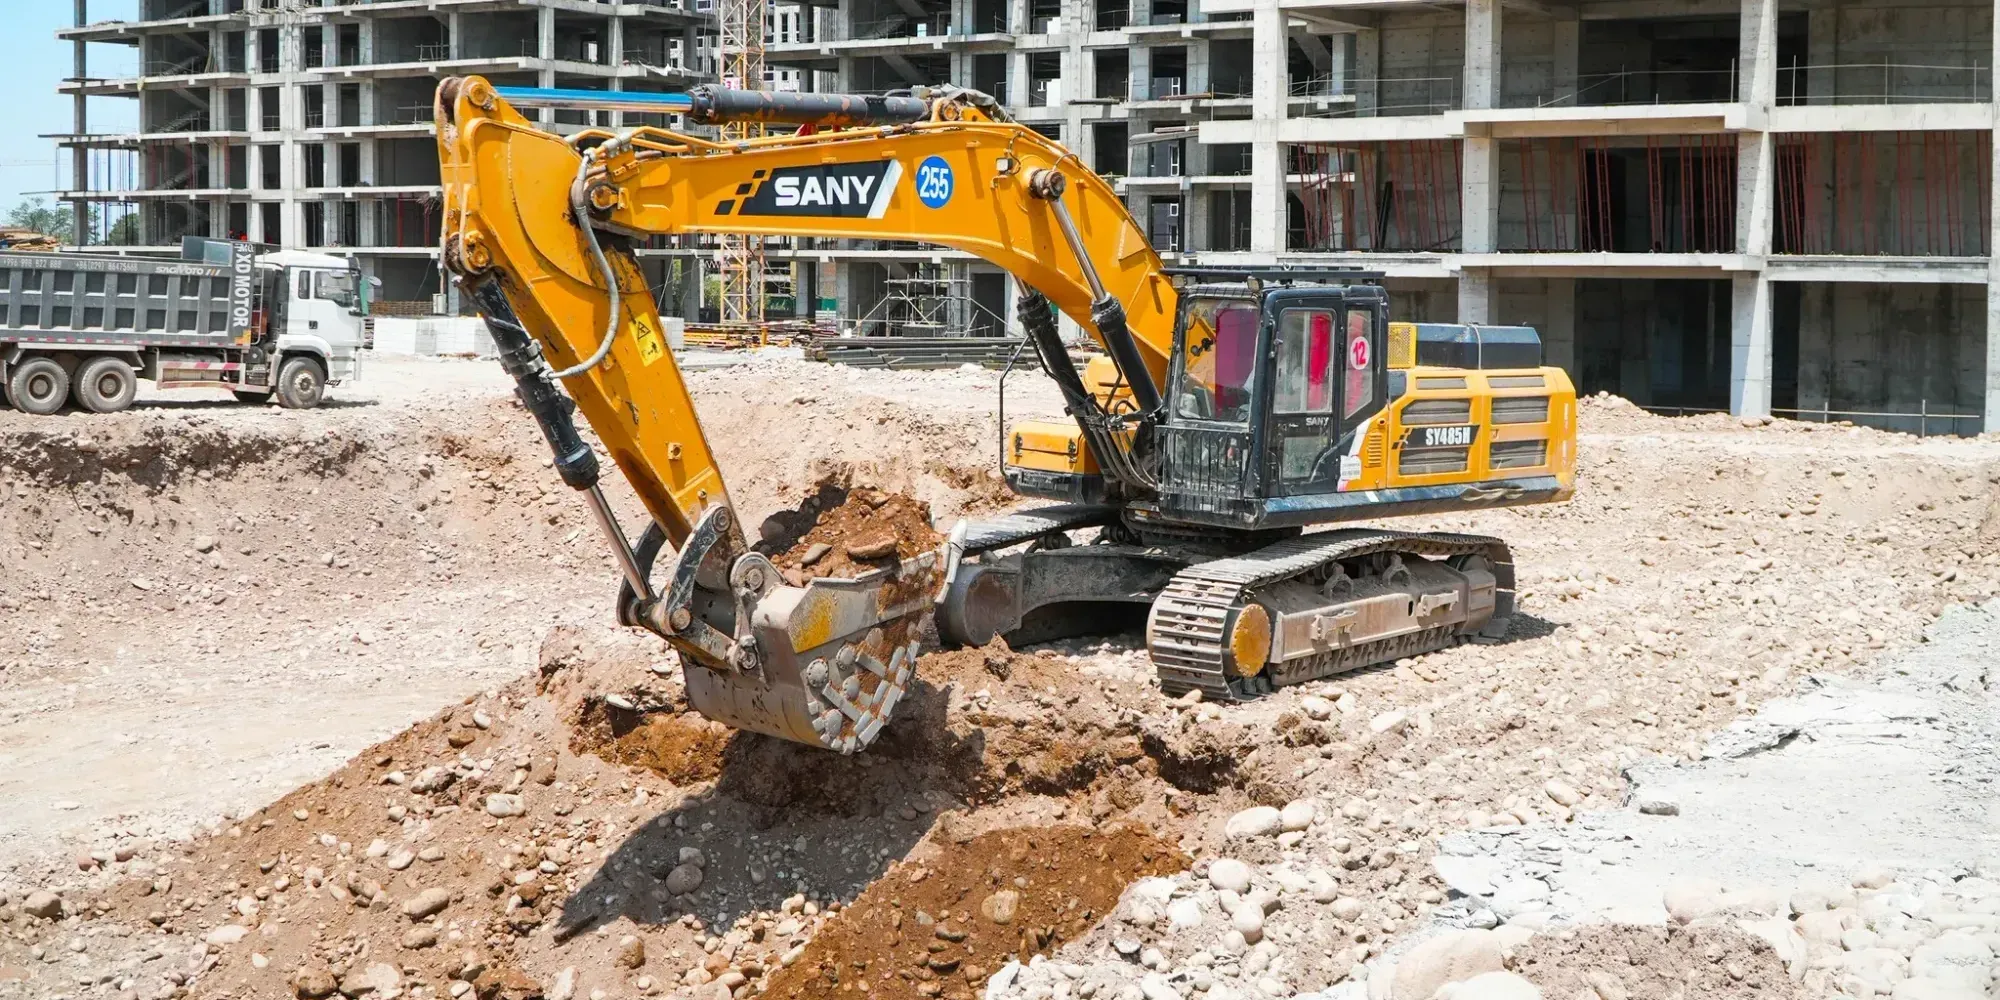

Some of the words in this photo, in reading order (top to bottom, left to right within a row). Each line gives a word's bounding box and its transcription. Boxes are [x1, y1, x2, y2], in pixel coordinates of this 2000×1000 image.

[774, 175, 875, 207] SANY
[920, 165, 949, 200] 255
[235, 253, 252, 273] XD
[232, 275, 250, 327] MOTOR
[1353, 341, 1366, 366] 12
[1305, 416, 1330, 427] SANY
[1425, 426, 1471, 446] SY485H
